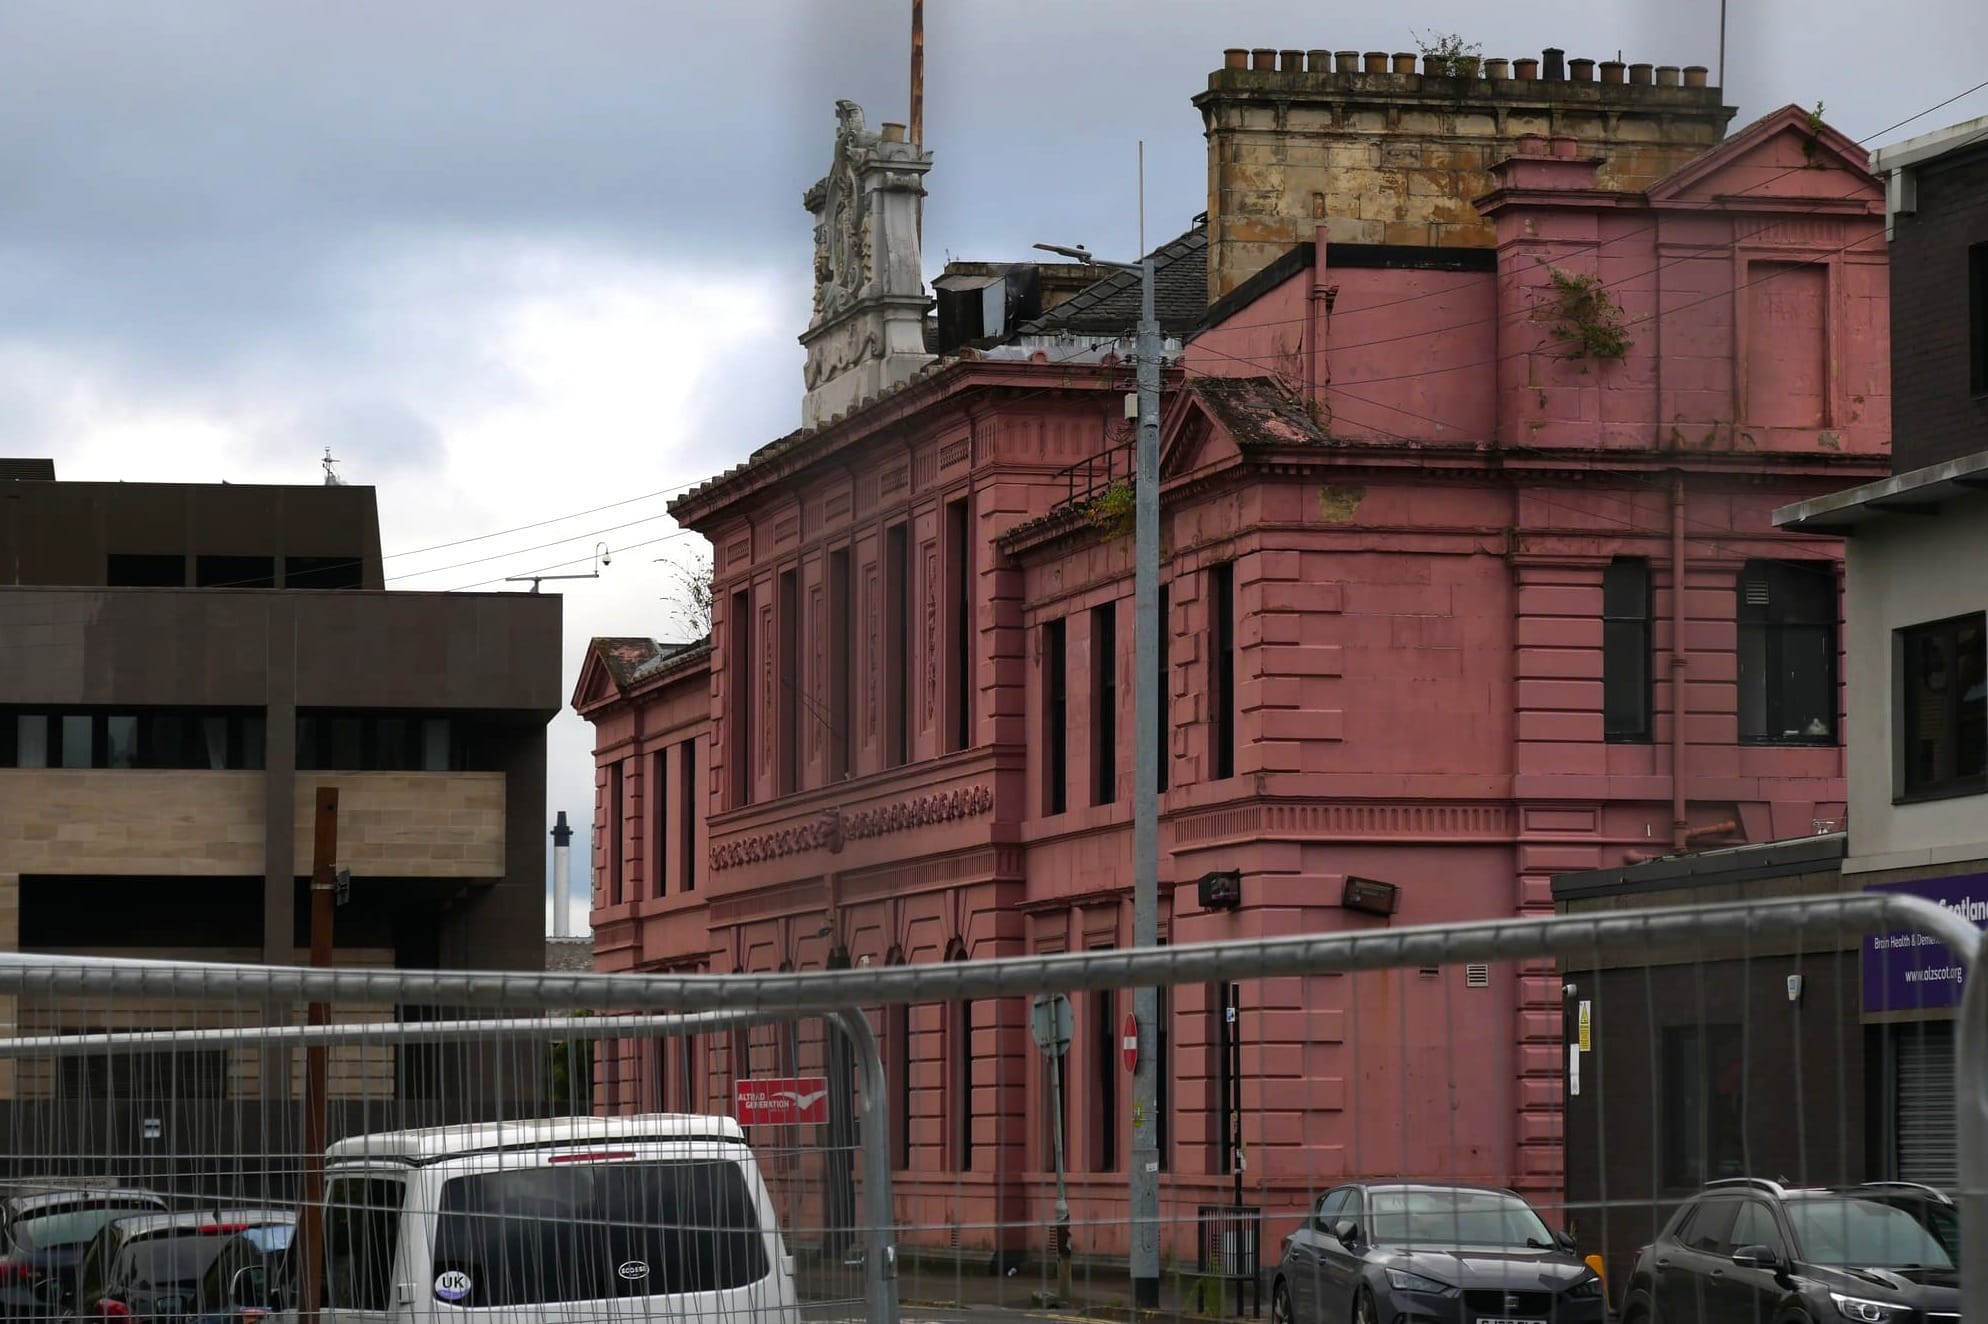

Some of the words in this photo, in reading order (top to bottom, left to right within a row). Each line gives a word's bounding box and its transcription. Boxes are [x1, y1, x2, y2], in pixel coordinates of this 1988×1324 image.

[1939, 896, 1988, 921] otlan
[1874, 937, 1890, 950] Brain
[1890, 935, 1910, 949] Health
[1911, 933, 1916, 947] &
[1917, 932, 1941, 946] Demen
[442, 1276, 464, 1289] UK
